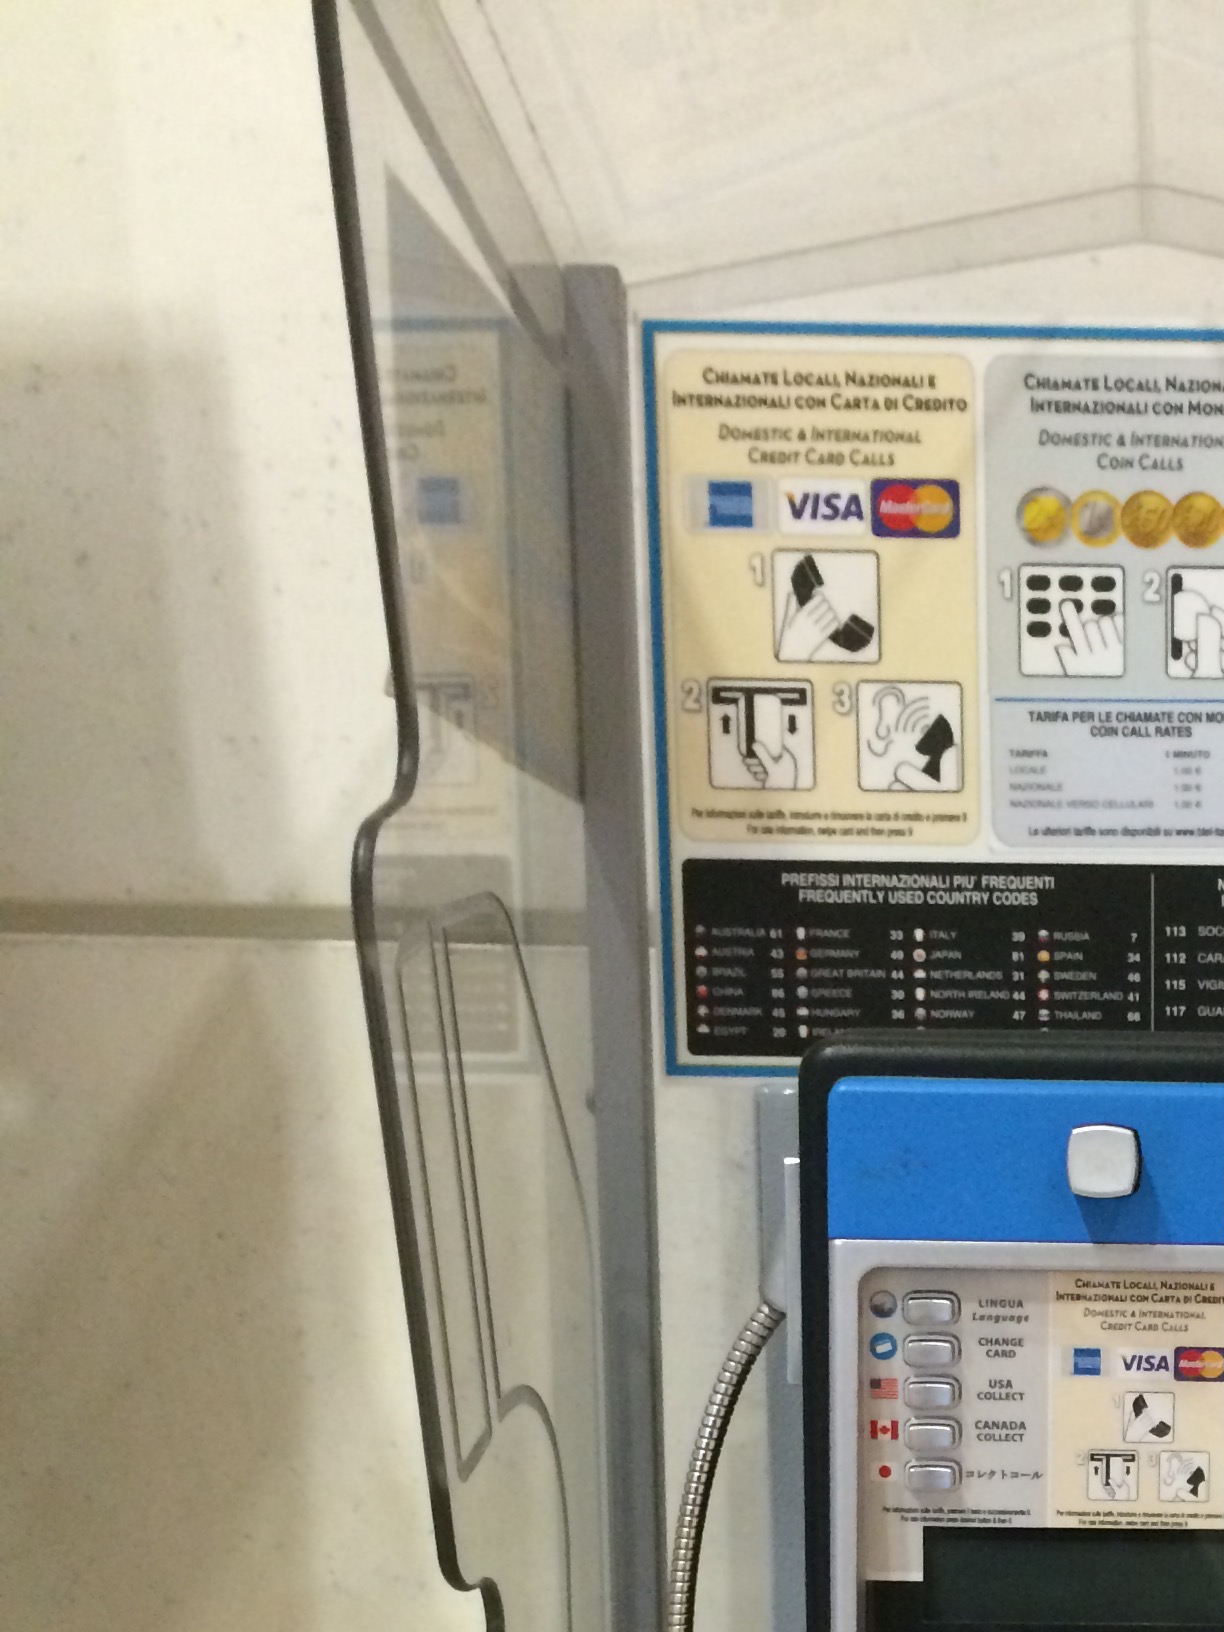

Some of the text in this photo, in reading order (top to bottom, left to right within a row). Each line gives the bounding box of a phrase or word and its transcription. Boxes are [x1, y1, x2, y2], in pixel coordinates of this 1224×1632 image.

[1073, 711, 1095, 723] PER
[1098, 712, 1113, 723] LE
[1116, 712, 1173, 723] CHIAMATE
[1177, 712, 1202, 723] CON
[1090, 726, 1192, 738] COIN CALL RATES
[782, 873, 839, 887] PREFISSI
[843, 874, 950, 888] INTERNAZIONALI
[982, 876, 1054, 889] FREQUENTI
[799, 889, 1038, 905] FREQUENTLY USED COUNTRY CODES
[1165, 953, 1186, 963] 112
[1165, 1007, 1186, 1016] 117
[979, 1299, 1023, 1308] LINGUA
[972, 1313, 1029, 1323] Language
[978, 1337, 1024, 1347] CHANGE
[986, 1349, 1016, 1358] CARD
[989, 1379, 1012, 1389] USA
[977, 1392, 1024, 1401] COLLECT
[975, 1420, 1026, 1431] CANADA
[977, 1433, 1024, 1442] COLLECT
